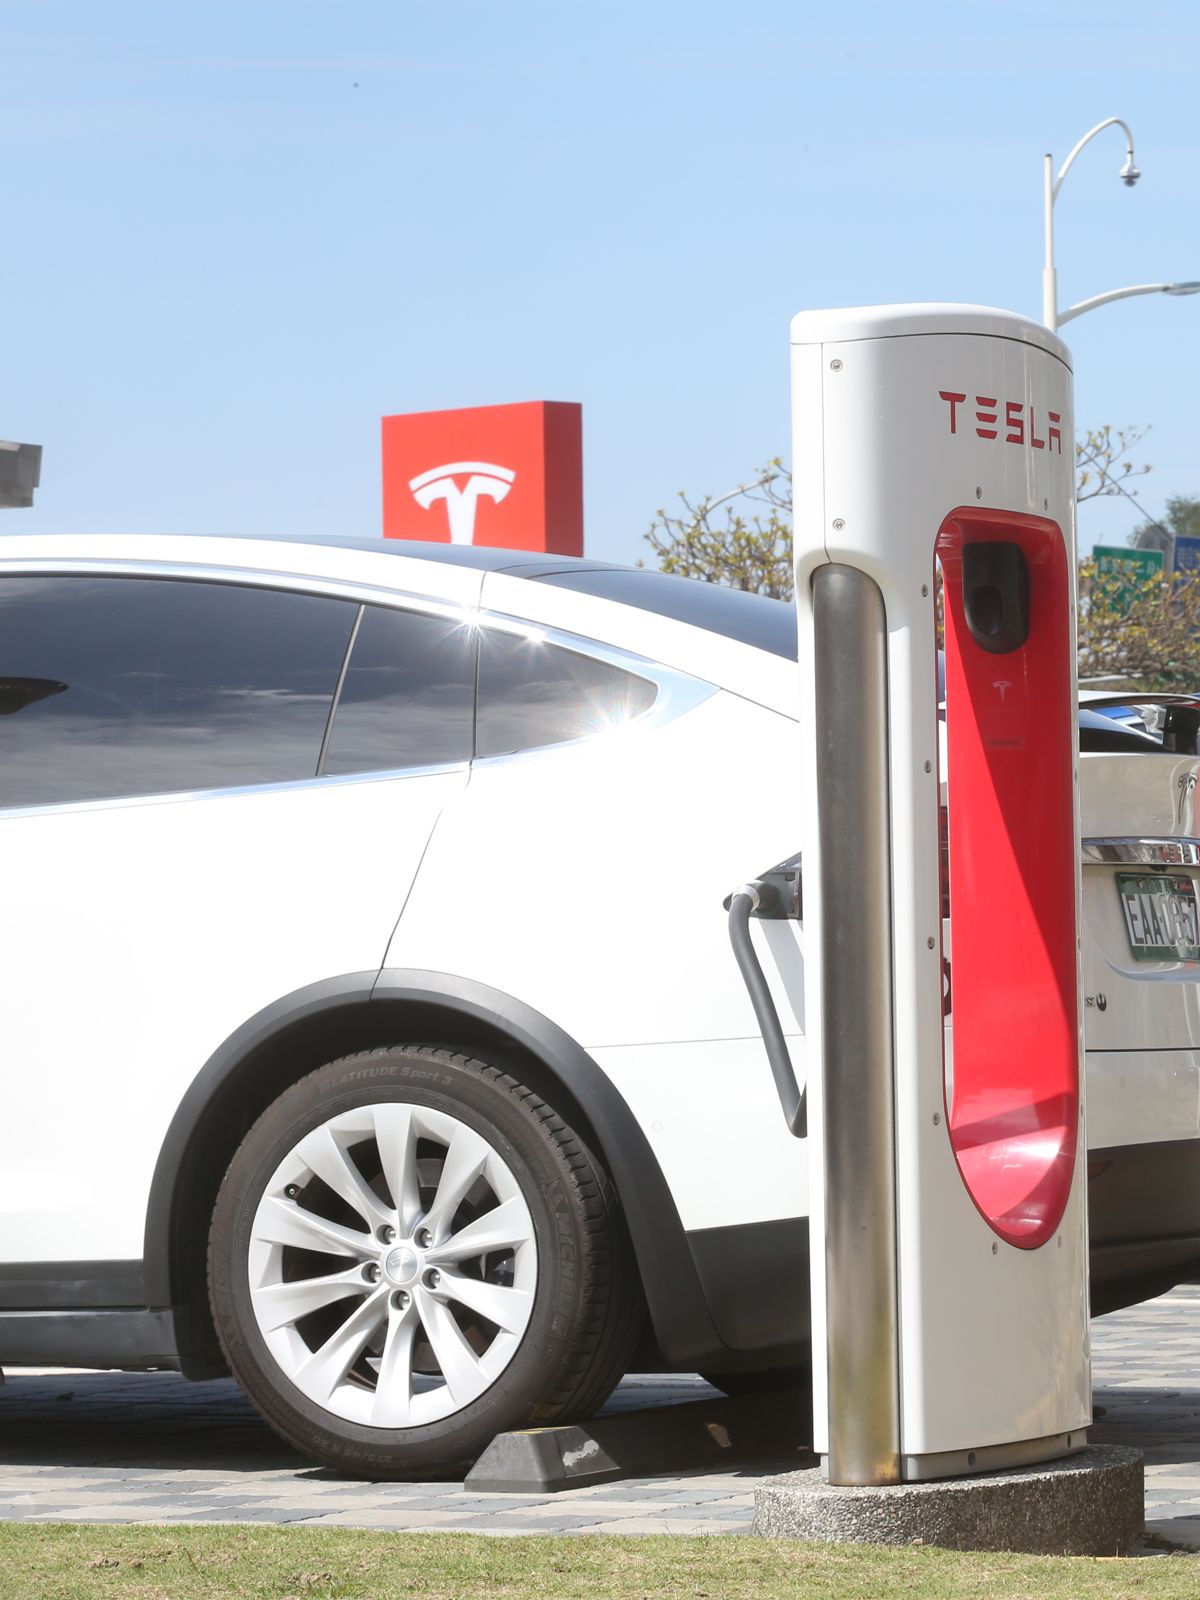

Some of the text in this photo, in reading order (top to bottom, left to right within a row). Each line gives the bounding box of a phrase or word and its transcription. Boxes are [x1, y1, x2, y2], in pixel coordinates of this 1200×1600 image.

[938, 390, 1062, 454] TESLA
[331, 1066, 453, 1088] LATITUDE Sport 3
